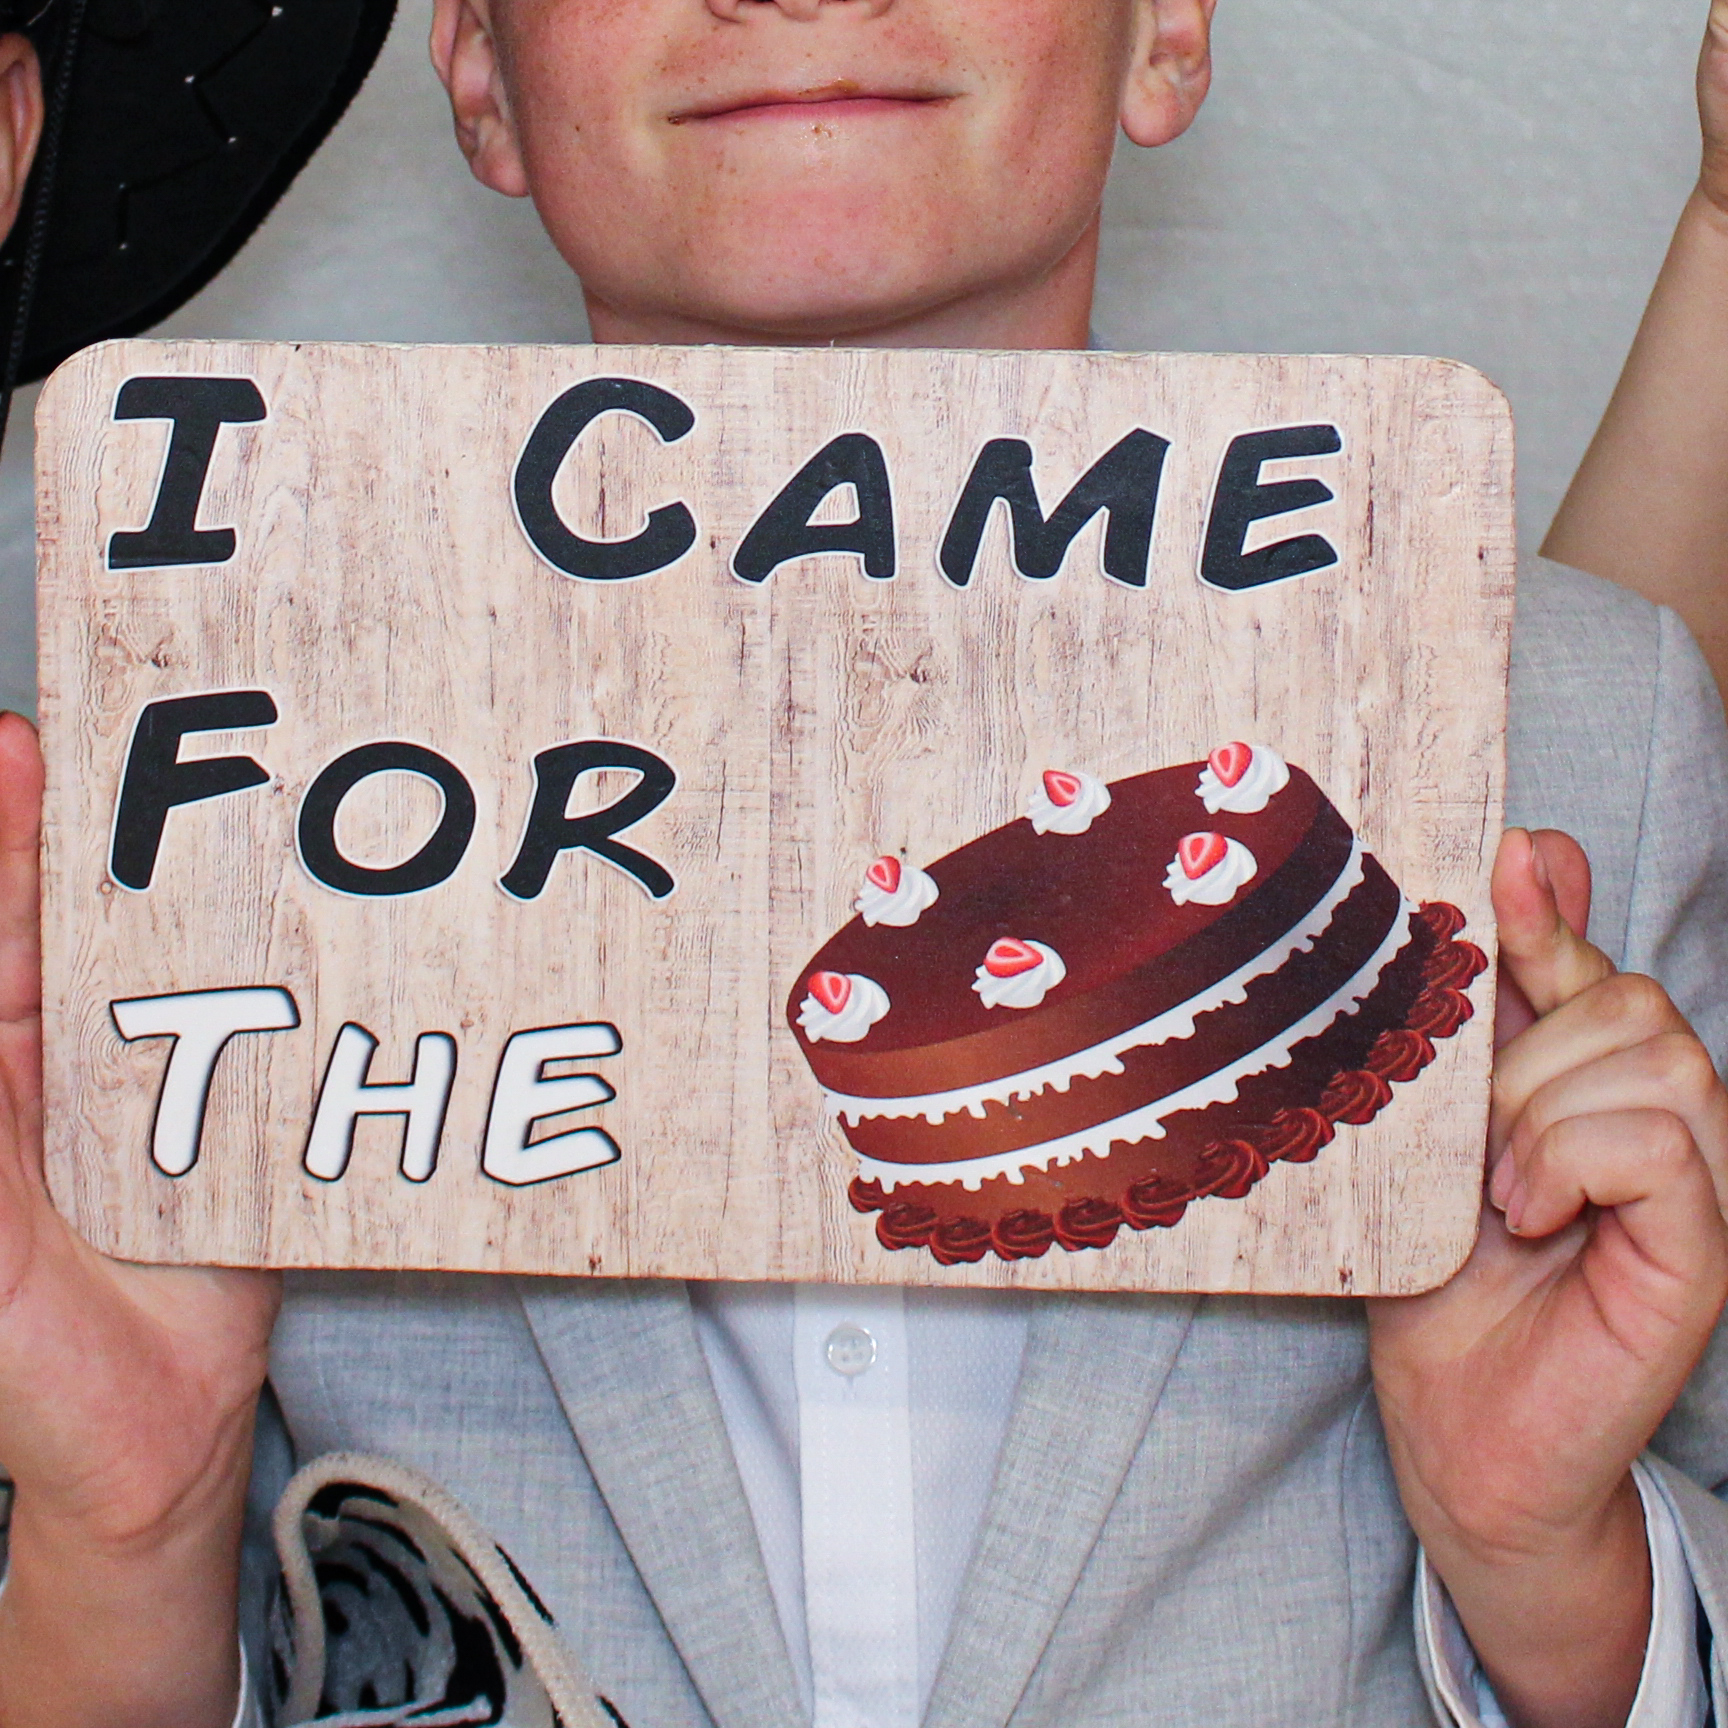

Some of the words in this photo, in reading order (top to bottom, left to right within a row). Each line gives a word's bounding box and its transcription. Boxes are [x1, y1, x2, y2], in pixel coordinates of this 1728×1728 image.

[107, 375, 268, 569] I
[514, 378, 1342, 593] CAME
[109, 692, 676, 899] FOR
[109, 986, 625, 1185] THE
